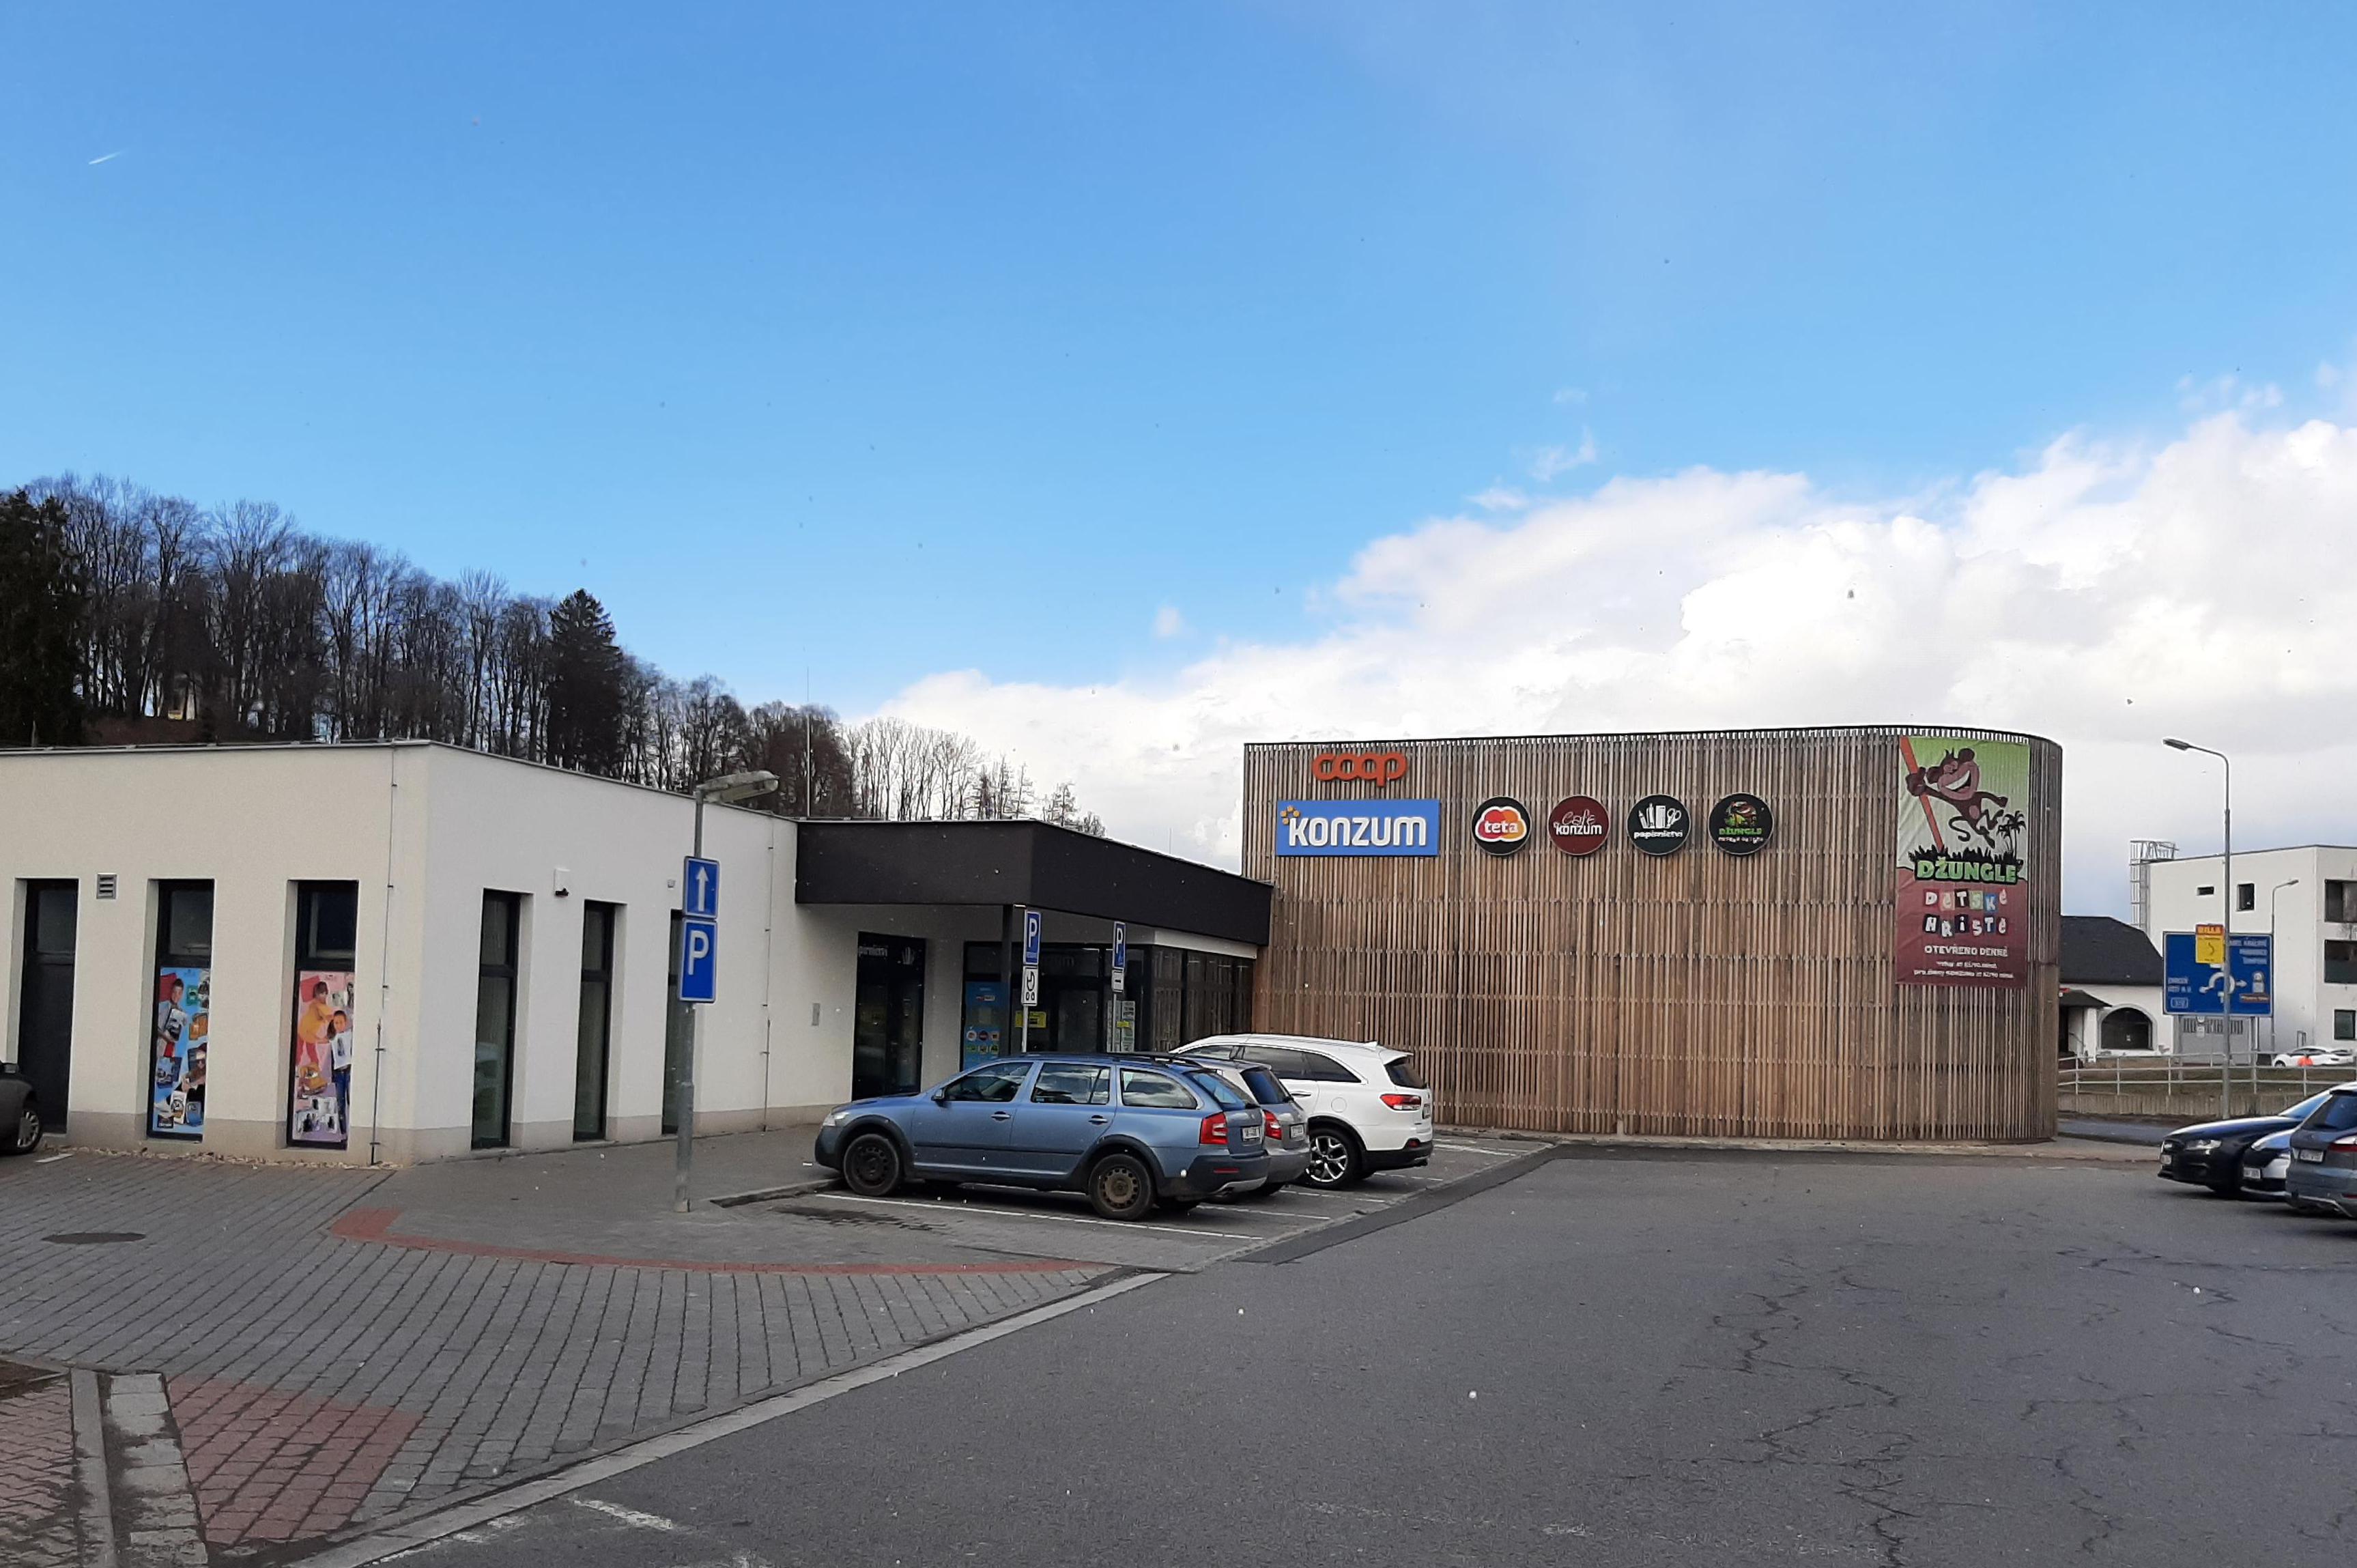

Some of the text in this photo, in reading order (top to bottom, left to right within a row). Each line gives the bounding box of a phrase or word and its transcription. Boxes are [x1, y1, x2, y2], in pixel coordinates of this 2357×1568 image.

[1312, 752, 1408, 787] coop
[1484, 821, 1519, 833] teta
[1917, 856, 2017, 883] DŽUNGLE
[1029, 917, 1038, 948] P
[1116, 928, 1124, 954] P
[688, 930, 709, 975] P
